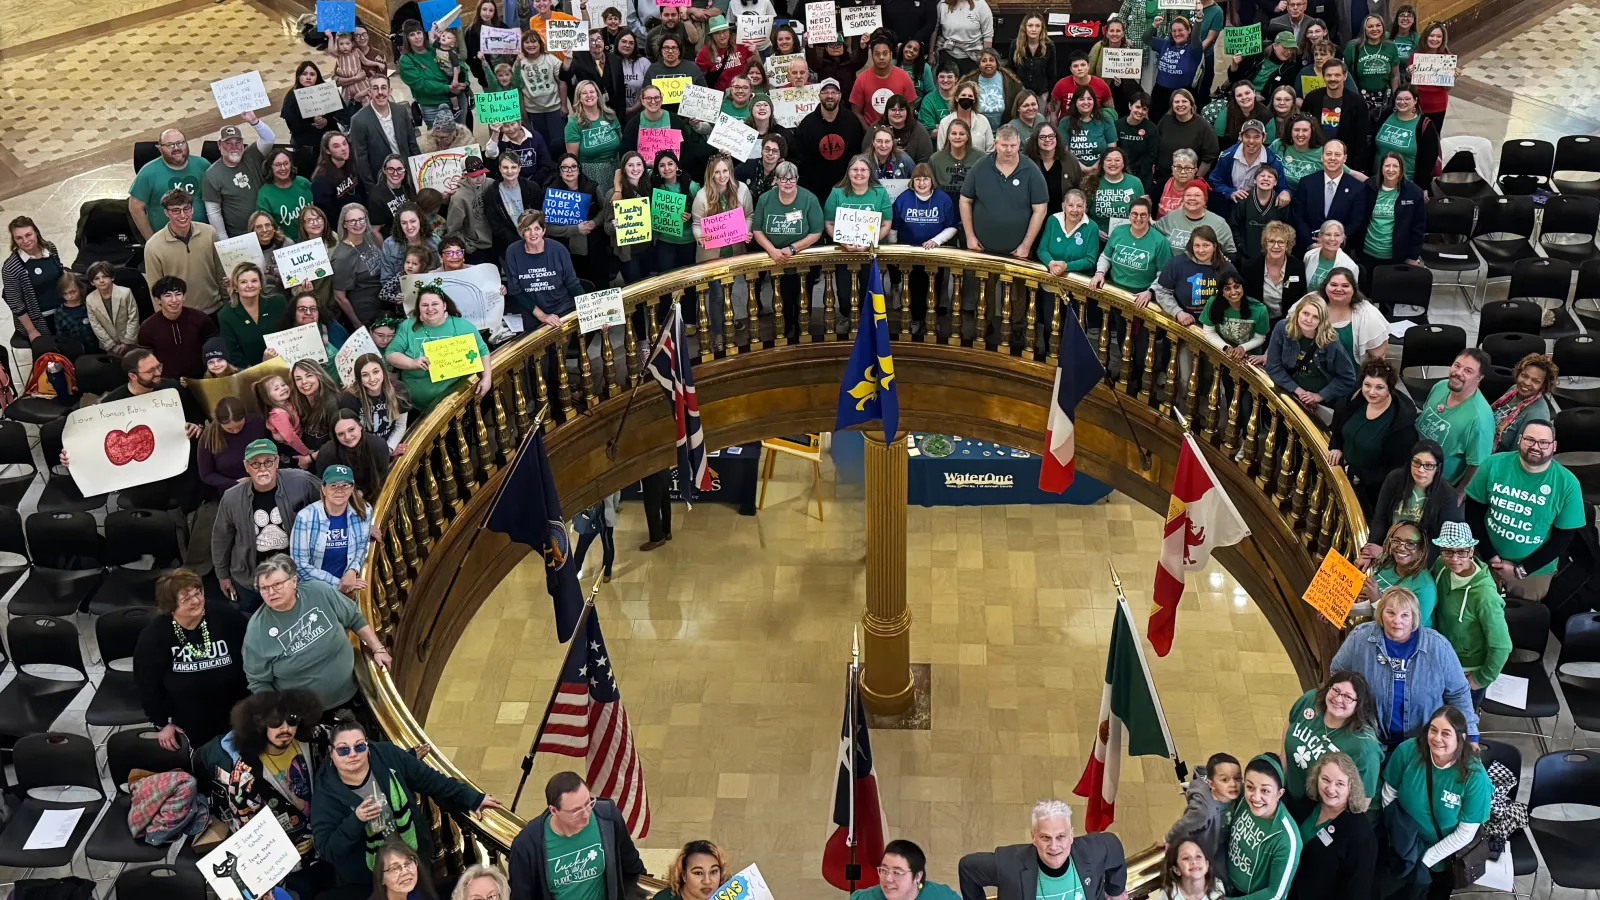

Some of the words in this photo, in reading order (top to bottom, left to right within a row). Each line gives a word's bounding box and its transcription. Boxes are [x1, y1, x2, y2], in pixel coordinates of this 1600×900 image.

[809, 24, 836, 32] MENTAL
[549, 29, 576, 40] FUND
[662, 80, 680, 89] NO
[796, 103, 815, 113] NOT
[1322, 113, 1338, 128] KC
[336, 177, 354, 195] NEA
[1096, 188, 1125, 196] PUBLIC
[549, 190, 582, 202] LUCKY
[656, 192, 683, 206] PUBLIC
[546, 199, 557, 208] TO
[558, 200, 570, 209] BE
[655, 201, 682, 214] MONEY
[1096, 206, 1126, 214] PUBLIC
[546, 208, 581, 218] KANSAS
[619, 206, 642, 216] Lucky
[660, 210, 672, 220] FOR
[906, 207, 939, 218] PROUD
[654, 215, 680, 227] PUBLIC
[704, 212, 734, 225] Protect
[838, 210, 880, 226] Inclusion
[616, 221, 644, 230] welcome
[654, 223, 681, 235] SCHOOLS
[704, 223, 727, 234] Public
[291, 252, 315, 266] LUCK
[590, 288, 620, 300] STUDENTS
[100, 408, 126, 419] Kansas
[152, 398, 178, 410] Schools
[944, 472, 1014, 484] WaterOne
[1493, 482, 1546, 506] KANSAS
[1490, 496, 1532, 516] NEEDS
[173, 662, 198, 672] KANSAS
[199, 657, 231, 670] EDUCATOR
[554, 852, 590, 874] lucky
[574, 866, 598, 880] SCHOOLS
